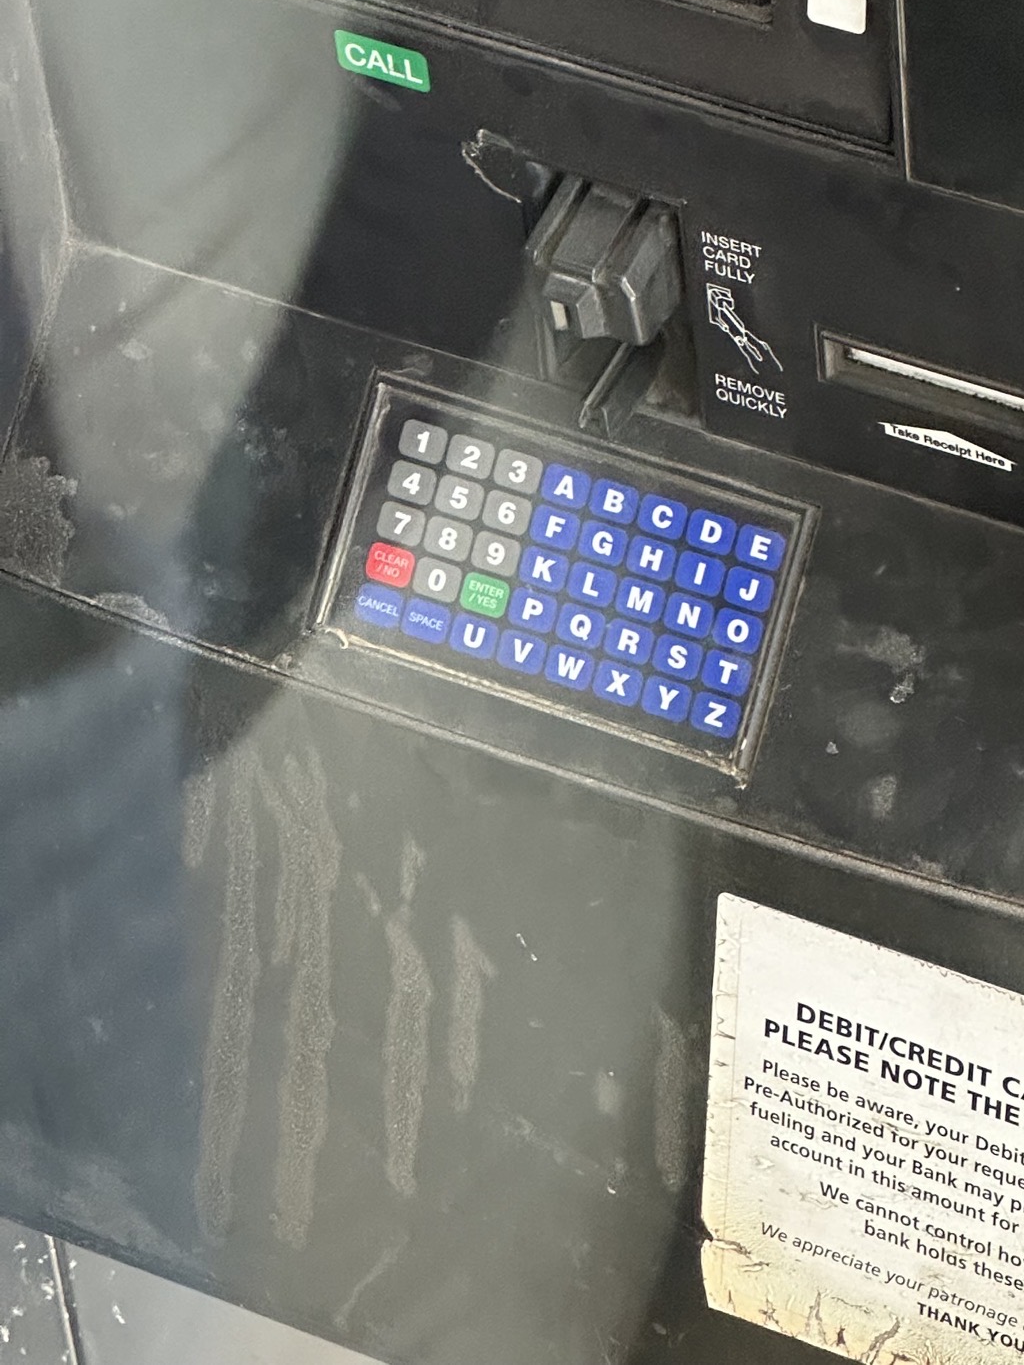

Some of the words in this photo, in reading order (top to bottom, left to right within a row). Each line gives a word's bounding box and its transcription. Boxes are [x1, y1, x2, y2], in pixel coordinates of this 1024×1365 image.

[345, 43, 423, 85] CALL
[702, 231, 762, 257] INSERT
[703, 246, 750, 268] CARD
[705, 260, 755, 284] FULLY
[715, 373, 785, 405] REMOVE
[716, 389, 787, 418] QUICKLY
[891, 425, 919, 441] Take
[923, 435, 971, 457] Receipt
[975, 447, 1005, 466] Here
[374, 550, 409, 567] CLEAR
[468, 580, 504, 599] ENTER
[358, 595, 398, 617] CANCEL
[408, 611, 444, 631] SPACE
[797, 1003, 992, 1086] DEBIT/CREDIT
[764, 1019, 869, 1072] PLEASE
[881, 1060, 956, 1103] NOTE
[968, 1090, 1020, 1126] THE
[763, 1059, 820, 1091] Please
[828, 1081, 849, 1102] be
[856, 1096, 918, 1129] aware,
[925, 1121, 968, 1144] your
[744, 1076, 884, 1138] Pre-Authorized
[891, 1131, 918, 1149] for
[924, 1143, 968, 1167] your
[750, 1101, 814, 1140] fueling
[822, 1131, 856, 1151] and
[862, 1145, 906, 1168] your
[912, 1160, 957, 1188] Bank
[964, 1182, 1004, 1207] may
[918, 1302, 980, 1337] THANK
